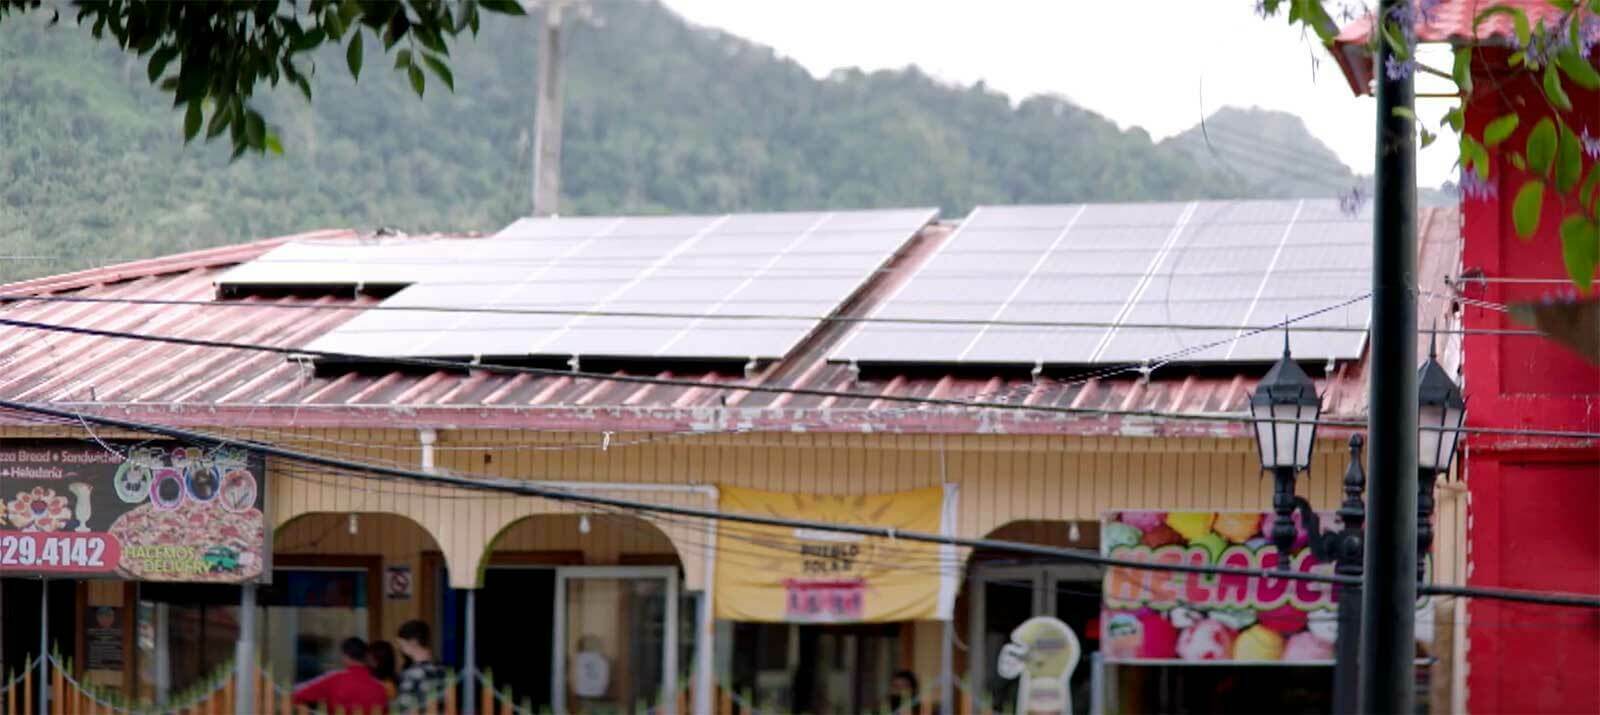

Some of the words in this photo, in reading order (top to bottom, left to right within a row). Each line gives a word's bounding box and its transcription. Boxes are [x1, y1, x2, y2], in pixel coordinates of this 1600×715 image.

[19, 449, 50, 463] Bread
[0, 536, 105, 567] 29.4142
[143, 559, 213, 574] DELIVERY
